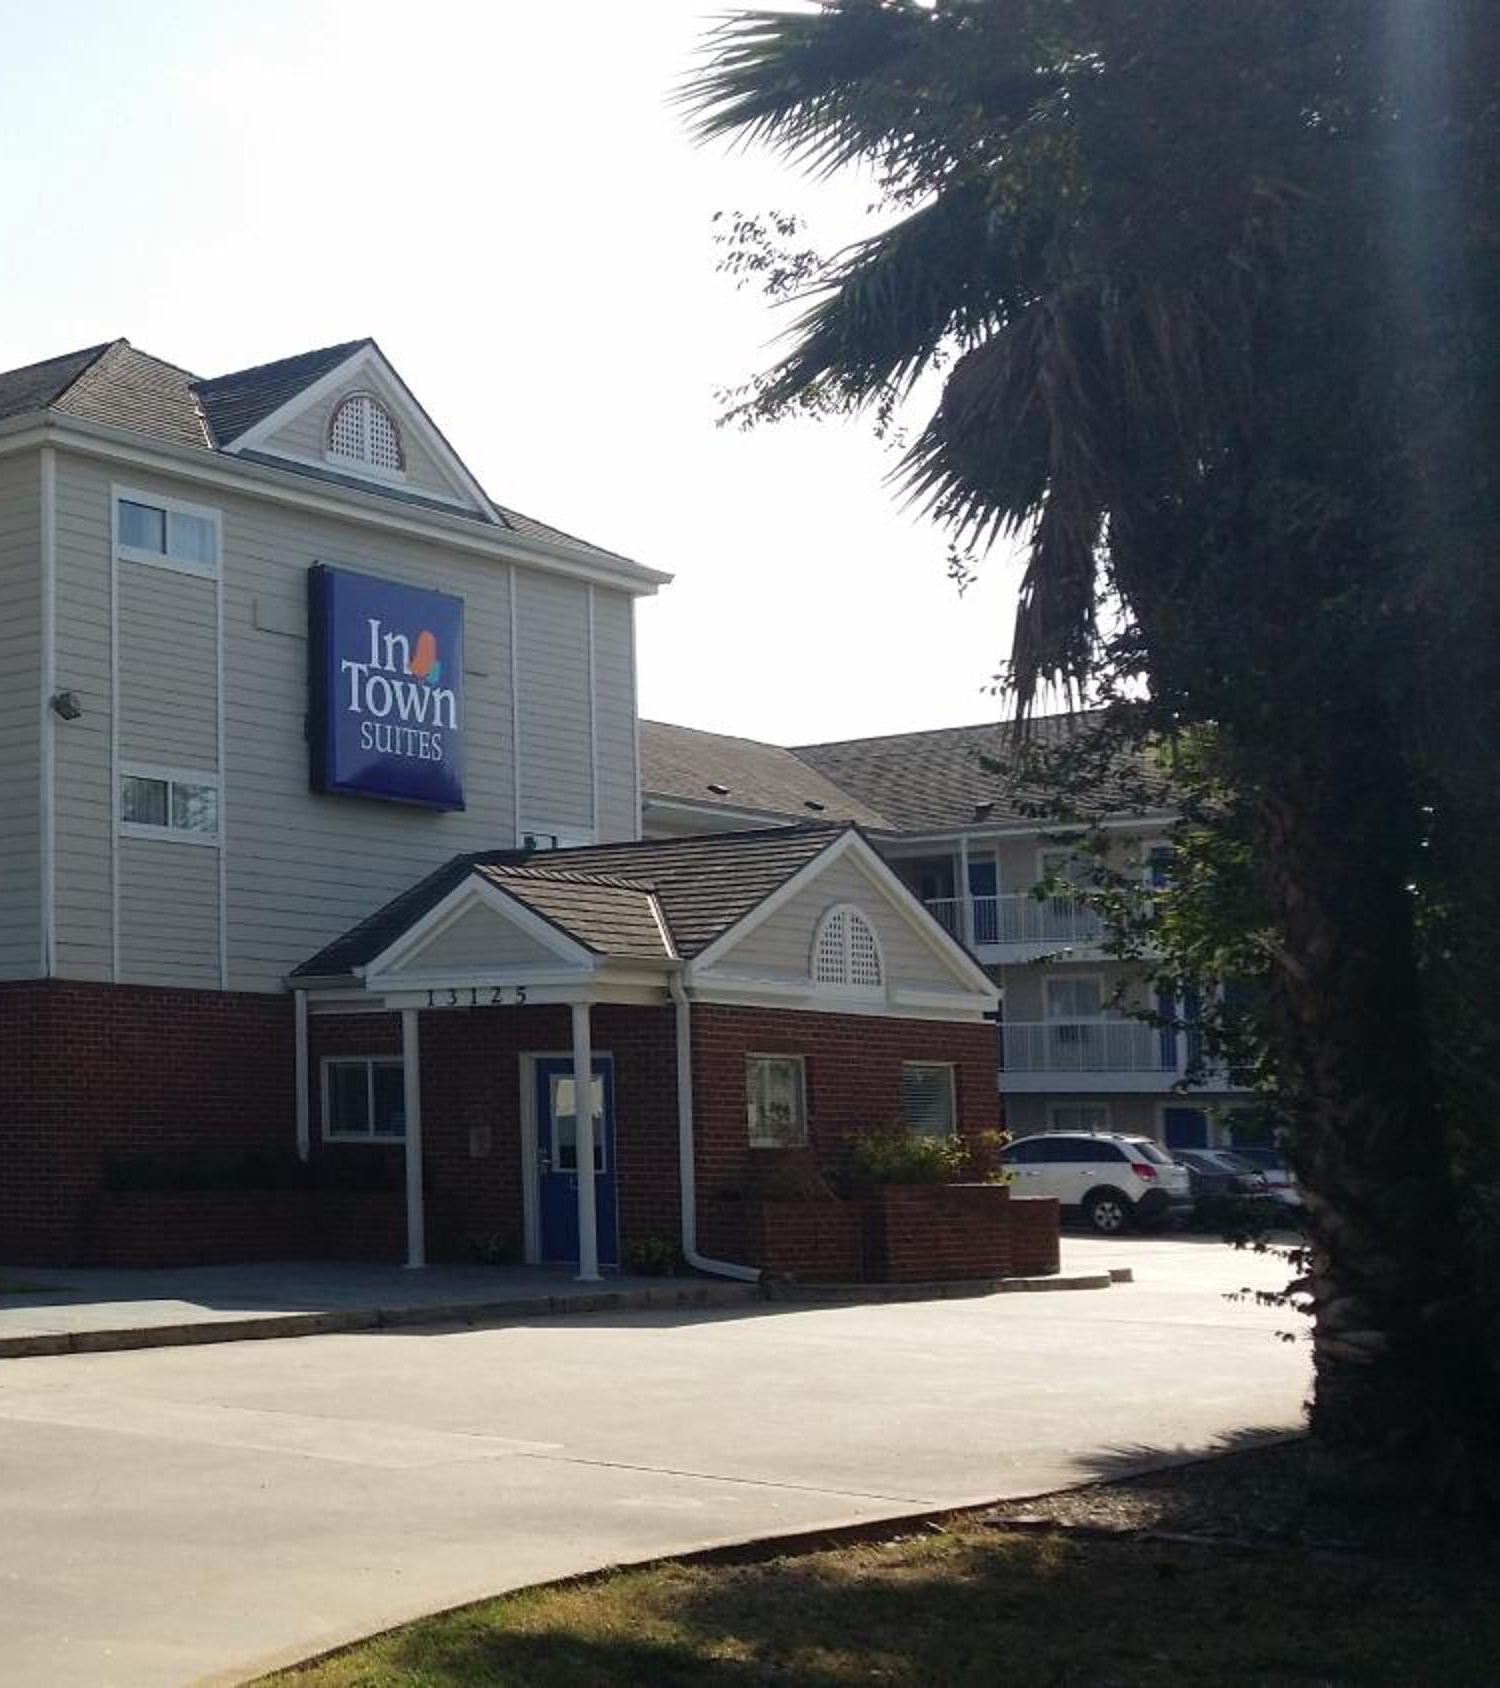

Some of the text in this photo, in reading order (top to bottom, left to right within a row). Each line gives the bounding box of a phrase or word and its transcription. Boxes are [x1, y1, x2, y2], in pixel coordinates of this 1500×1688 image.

[368, 618, 412, 675] In
[341, 659, 457, 729] Town
[360, 721, 443, 761] SUITES
[427, 985, 526, 1008] 13125
